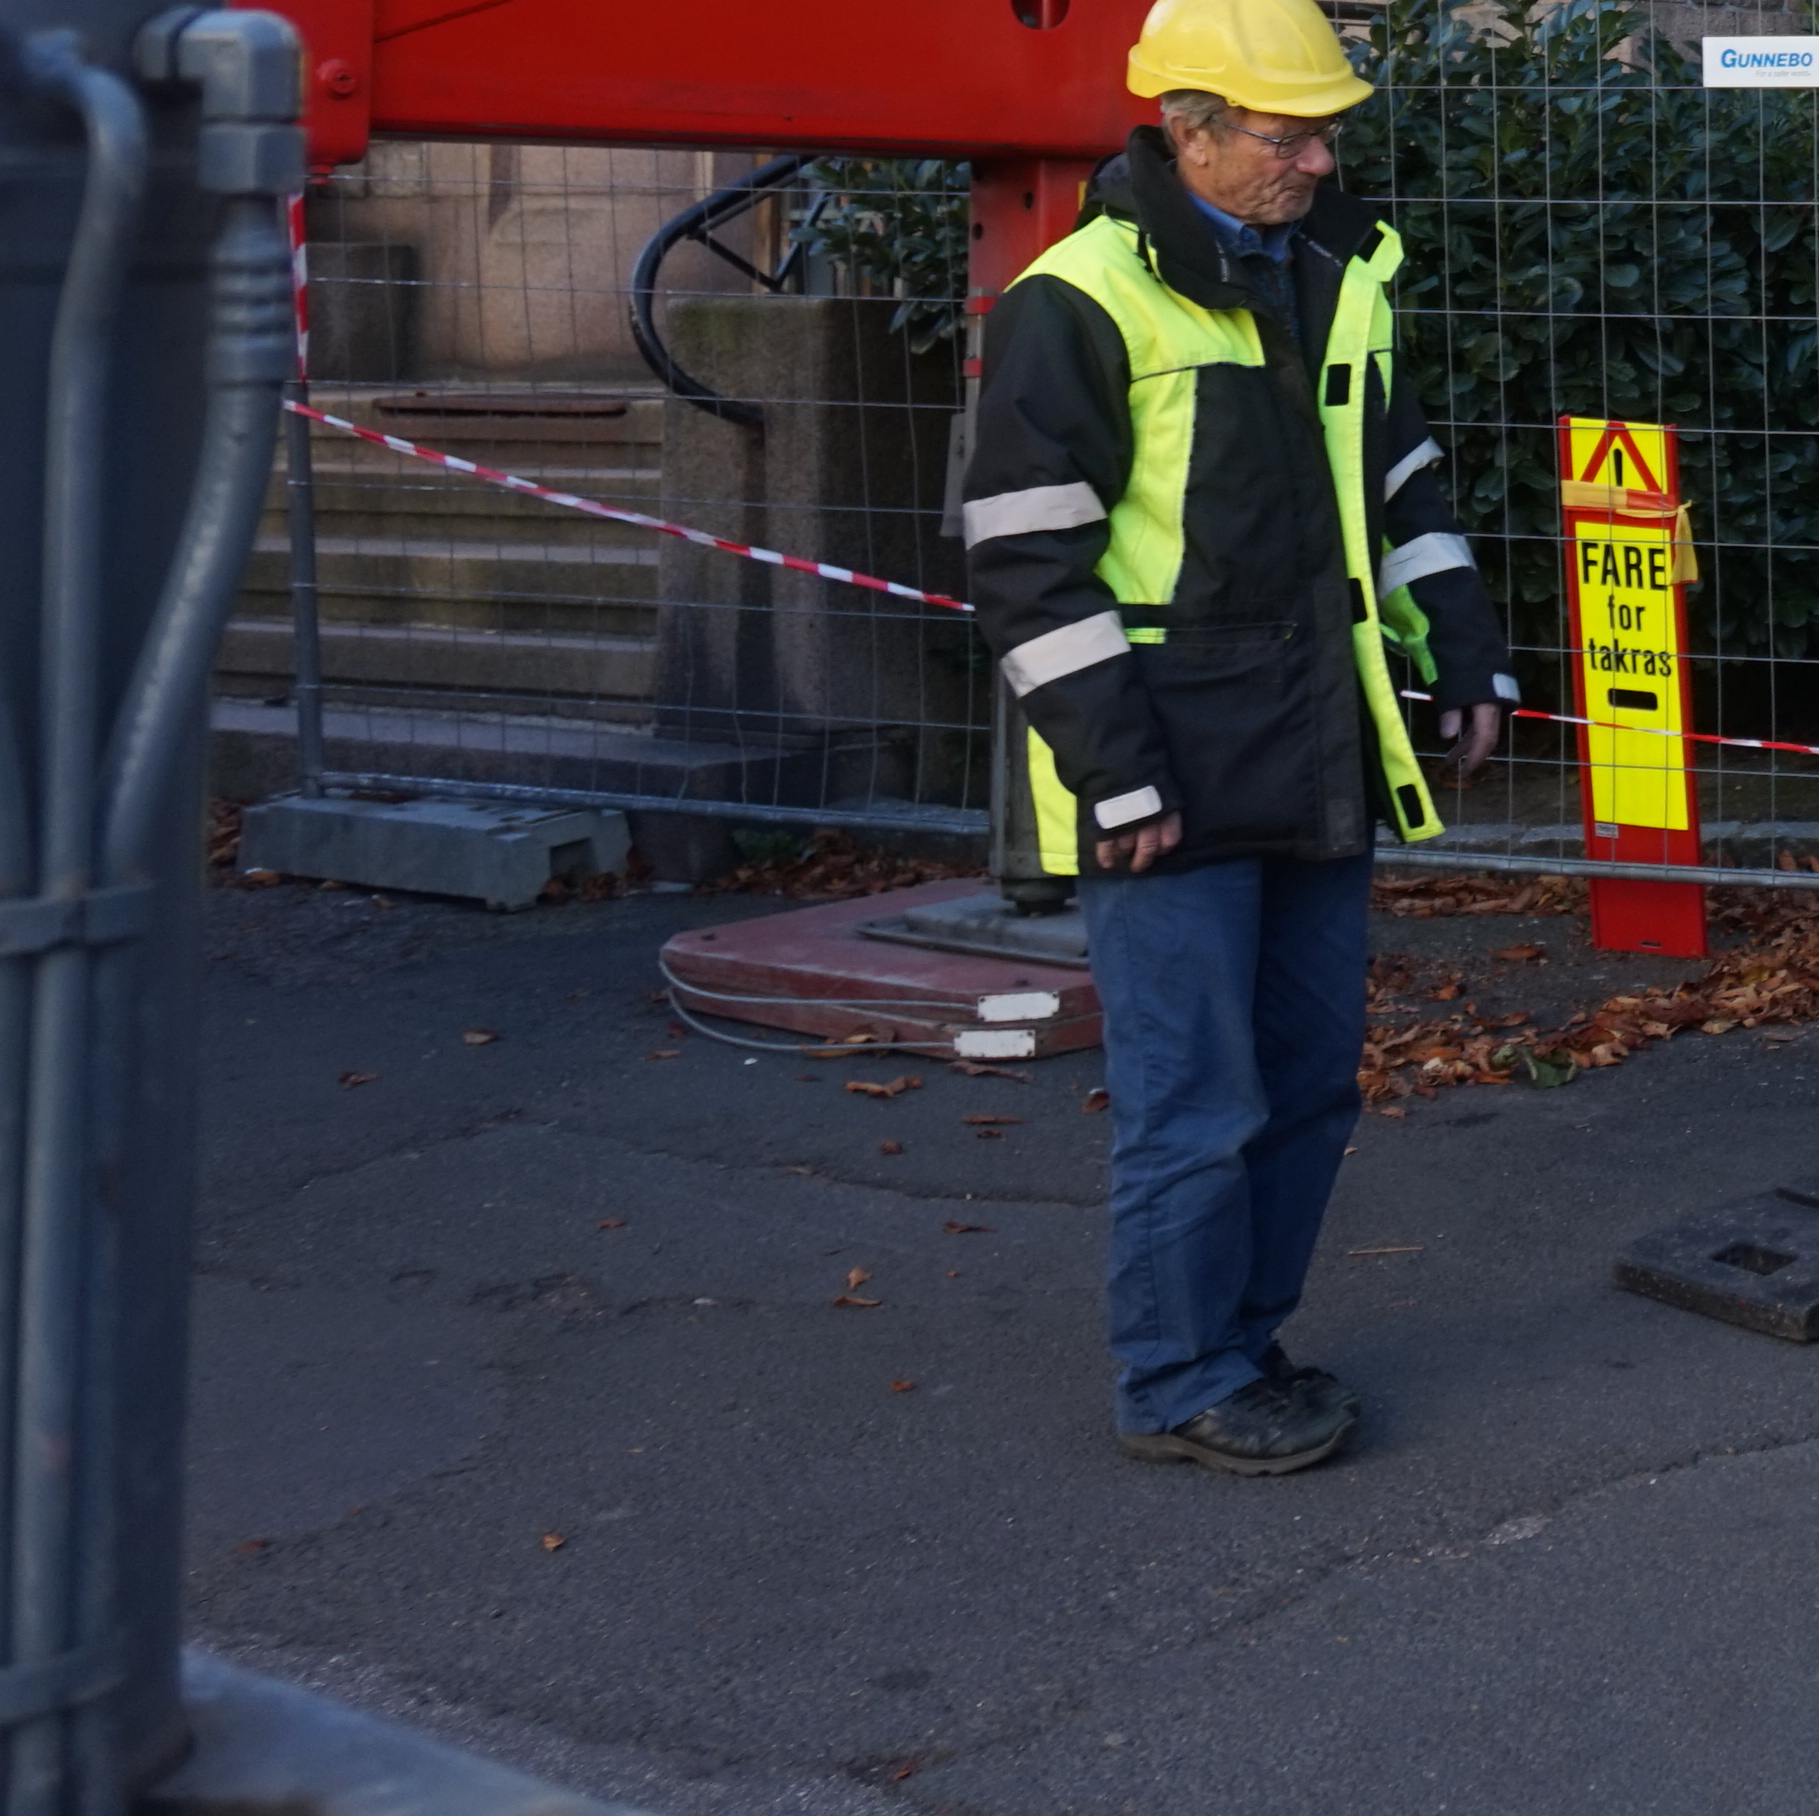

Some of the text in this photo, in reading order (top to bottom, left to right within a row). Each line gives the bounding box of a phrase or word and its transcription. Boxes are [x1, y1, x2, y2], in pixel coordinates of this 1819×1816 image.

[1721, 48, 1813, 68] GUNNEBO
[1581, 541, 1668, 591] FARE
[1607, 594, 1646, 632] for
[1588, 637, 1672, 677] takras
